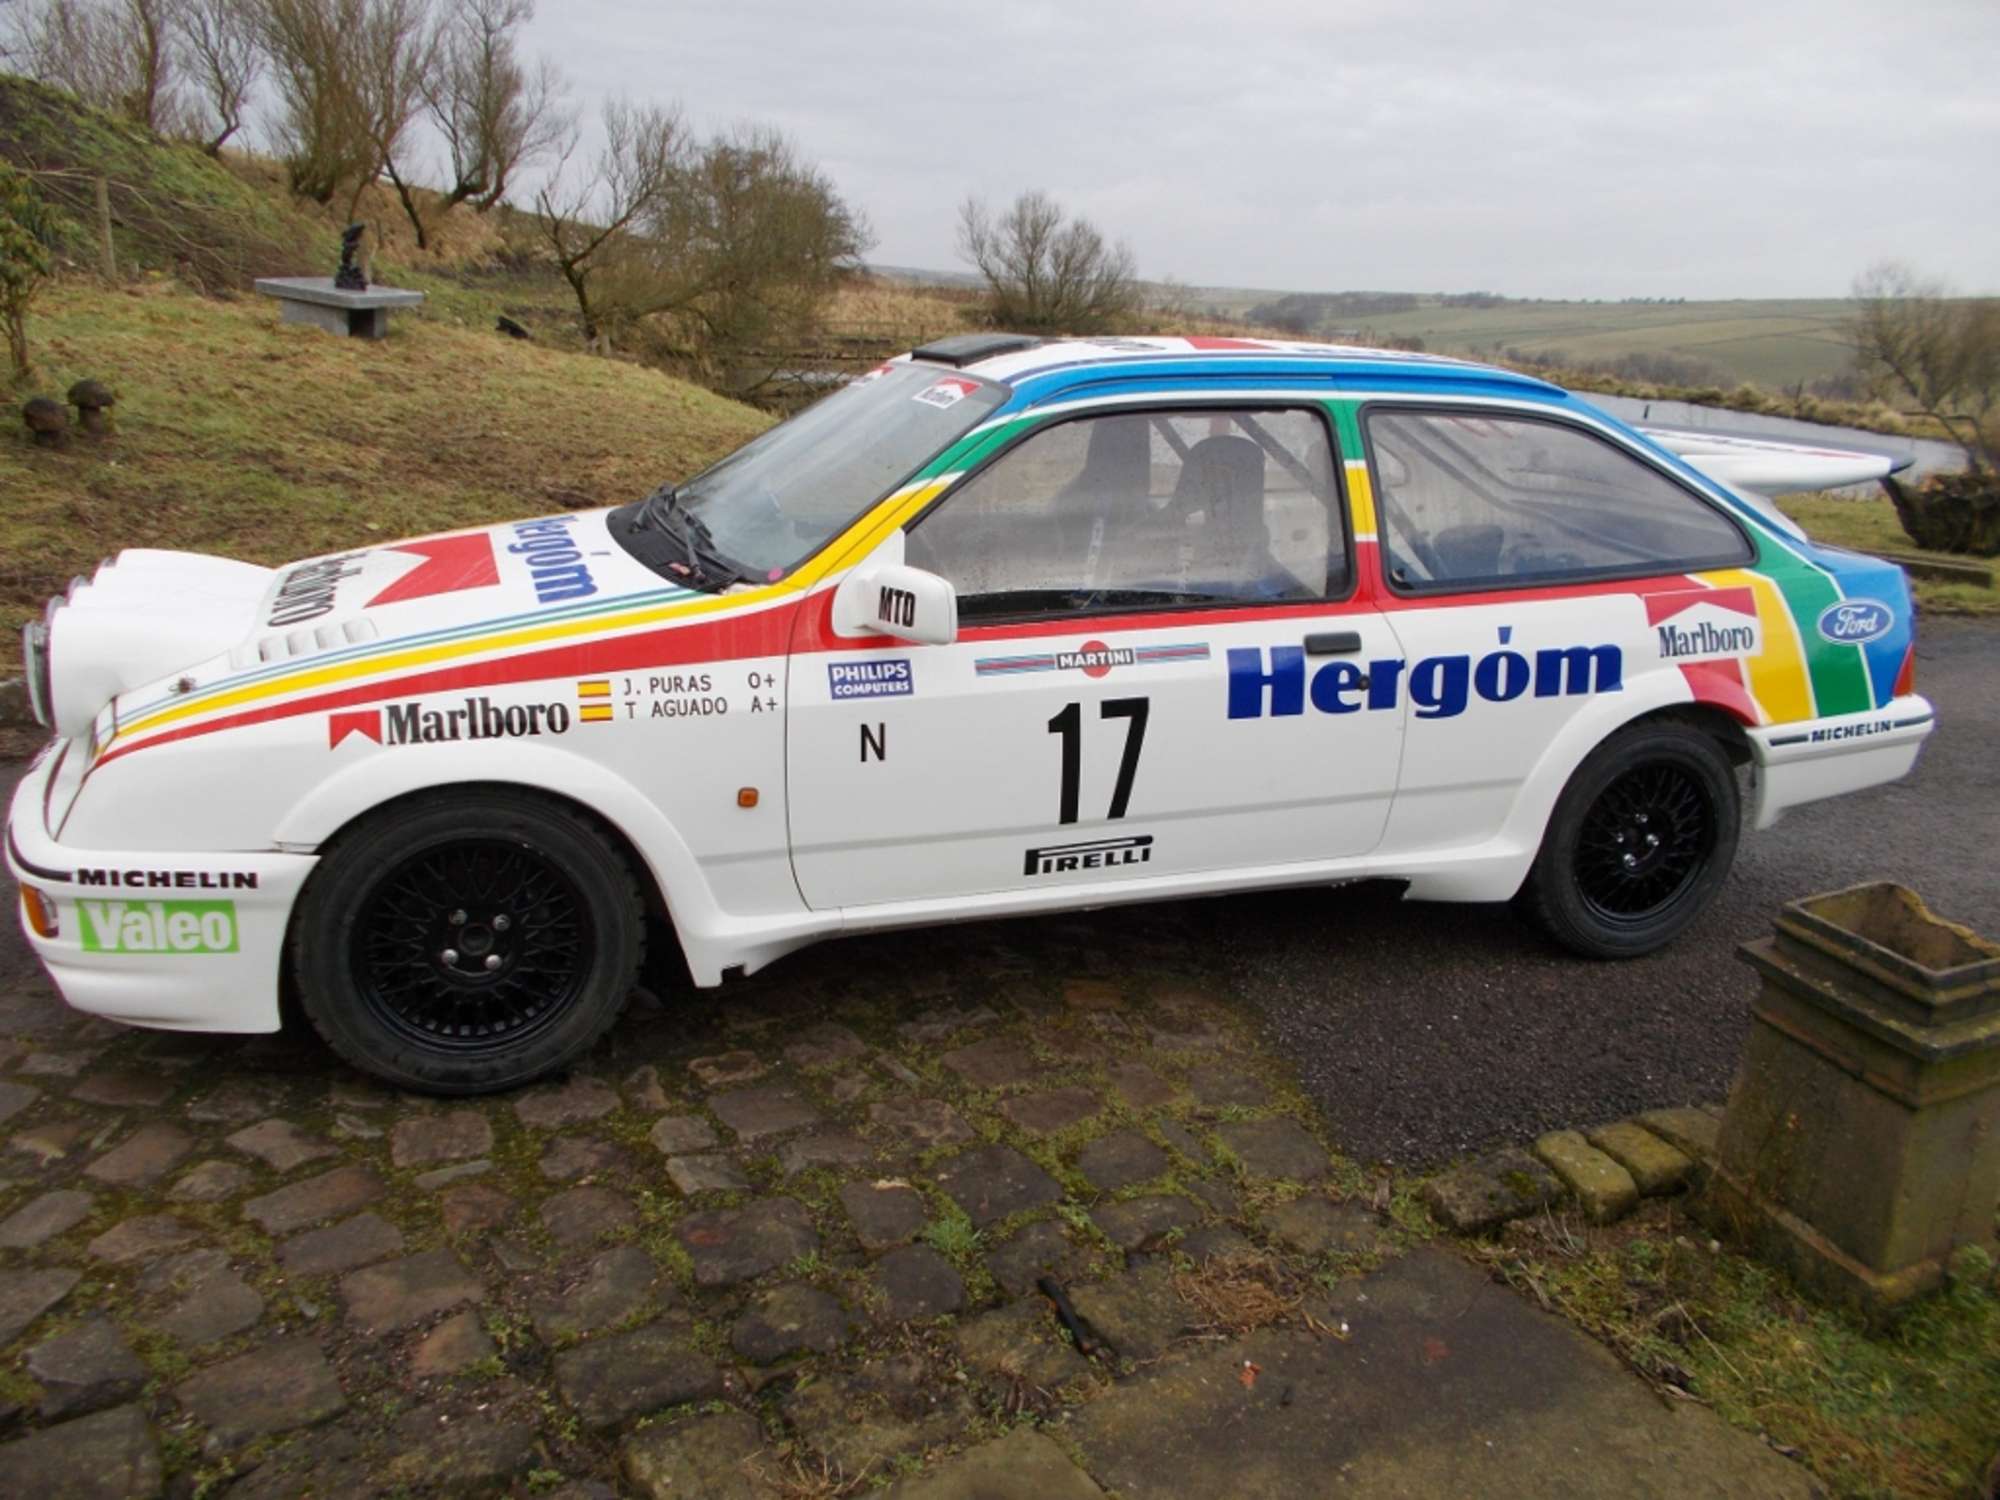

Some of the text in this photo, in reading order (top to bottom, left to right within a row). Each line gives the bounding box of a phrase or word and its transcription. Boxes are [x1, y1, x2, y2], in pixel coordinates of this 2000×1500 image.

[1834, 606, 1878, 635] Ford
[1658, 621, 1754, 658] Marlboro
[832, 663, 908, 682] PHILIPS
[1060, 650, 1131, 669] MARTINI
[1226, 626, 1623, 719] Hergóm
[624, 678, 641, 696] J.
[650, 675, 712, 694] PURAS
[834, 681, 909, 696] COMPUTERS
[386, 697, 570, 745] Marlboro
[625, 696, 778, 719] T AGUADO A+
[861, 722, 886, 762] N
[1812, 720, 1891, 742] MICHELIN
[1048, 697, 1150, 825] 17
[1024, 835, 1153, 876] PIRELLI
[77, 868, 259, 889] MICHELIN
[83, 901, 233, 950] Valeo
